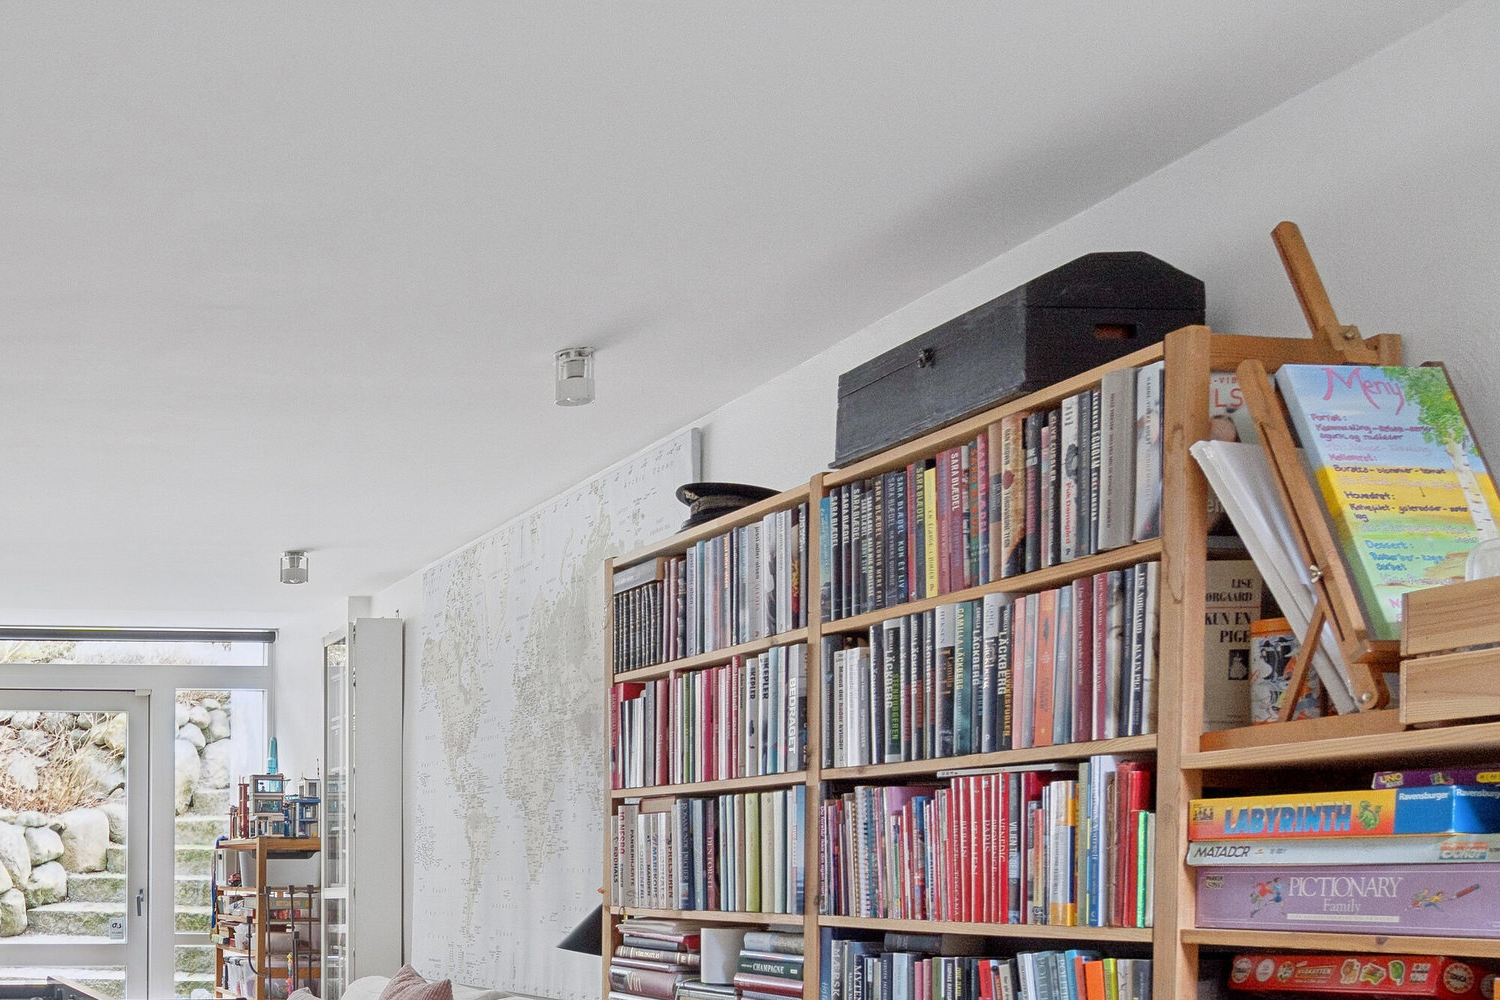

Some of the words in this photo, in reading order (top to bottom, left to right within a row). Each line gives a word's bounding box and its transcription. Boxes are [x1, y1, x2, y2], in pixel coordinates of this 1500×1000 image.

[1091, 430, 1100, 469] EGHOLM
[951, 478, 959, 512] BLÆDEL
[1064, 501, 1073, 544] Damsgård
[898, 562, 906, 571] ÉT
[1231, 579, 1252, 588] LISE
[1136, 592, 1144, 633] NØRGAARD
[1205, 612, 1230, 625] KUN
[1235, 613, 1251, 625] EN
[1220, 631, 1251, 642] PIGE
[972, 630, 981, 686] LÄCKBERG
[983, 638, 994, 688] Läckberg
[998, 631, 1009, 695] LÄCKBERG
[1135, 662, 1141, 672] EN
[885, 651, 894, 708] LÄCKBERG
[788, 677, 796, 754] BEDRAGET
[892, 674, 900, 739] STENHUGGEREN
[1380, 773, 1403, 783] UNO
[1399, 792, 1450, 800] Ravensburger
[1224, 801, 1352, 834] LABYRINTH
[1009, 822, 1017, 846] VILJEN
[1194, 846, 1250, 858] MATADOR
[1288, 876, 1403, 897] PICTIONARY
[1323, 900, 1361, 914] Family
[753, 963, 784, 974] CHAMPAGNE
[832, 948, 840, 996] MÆRSK
[627, 971, 642, 991] Vin
